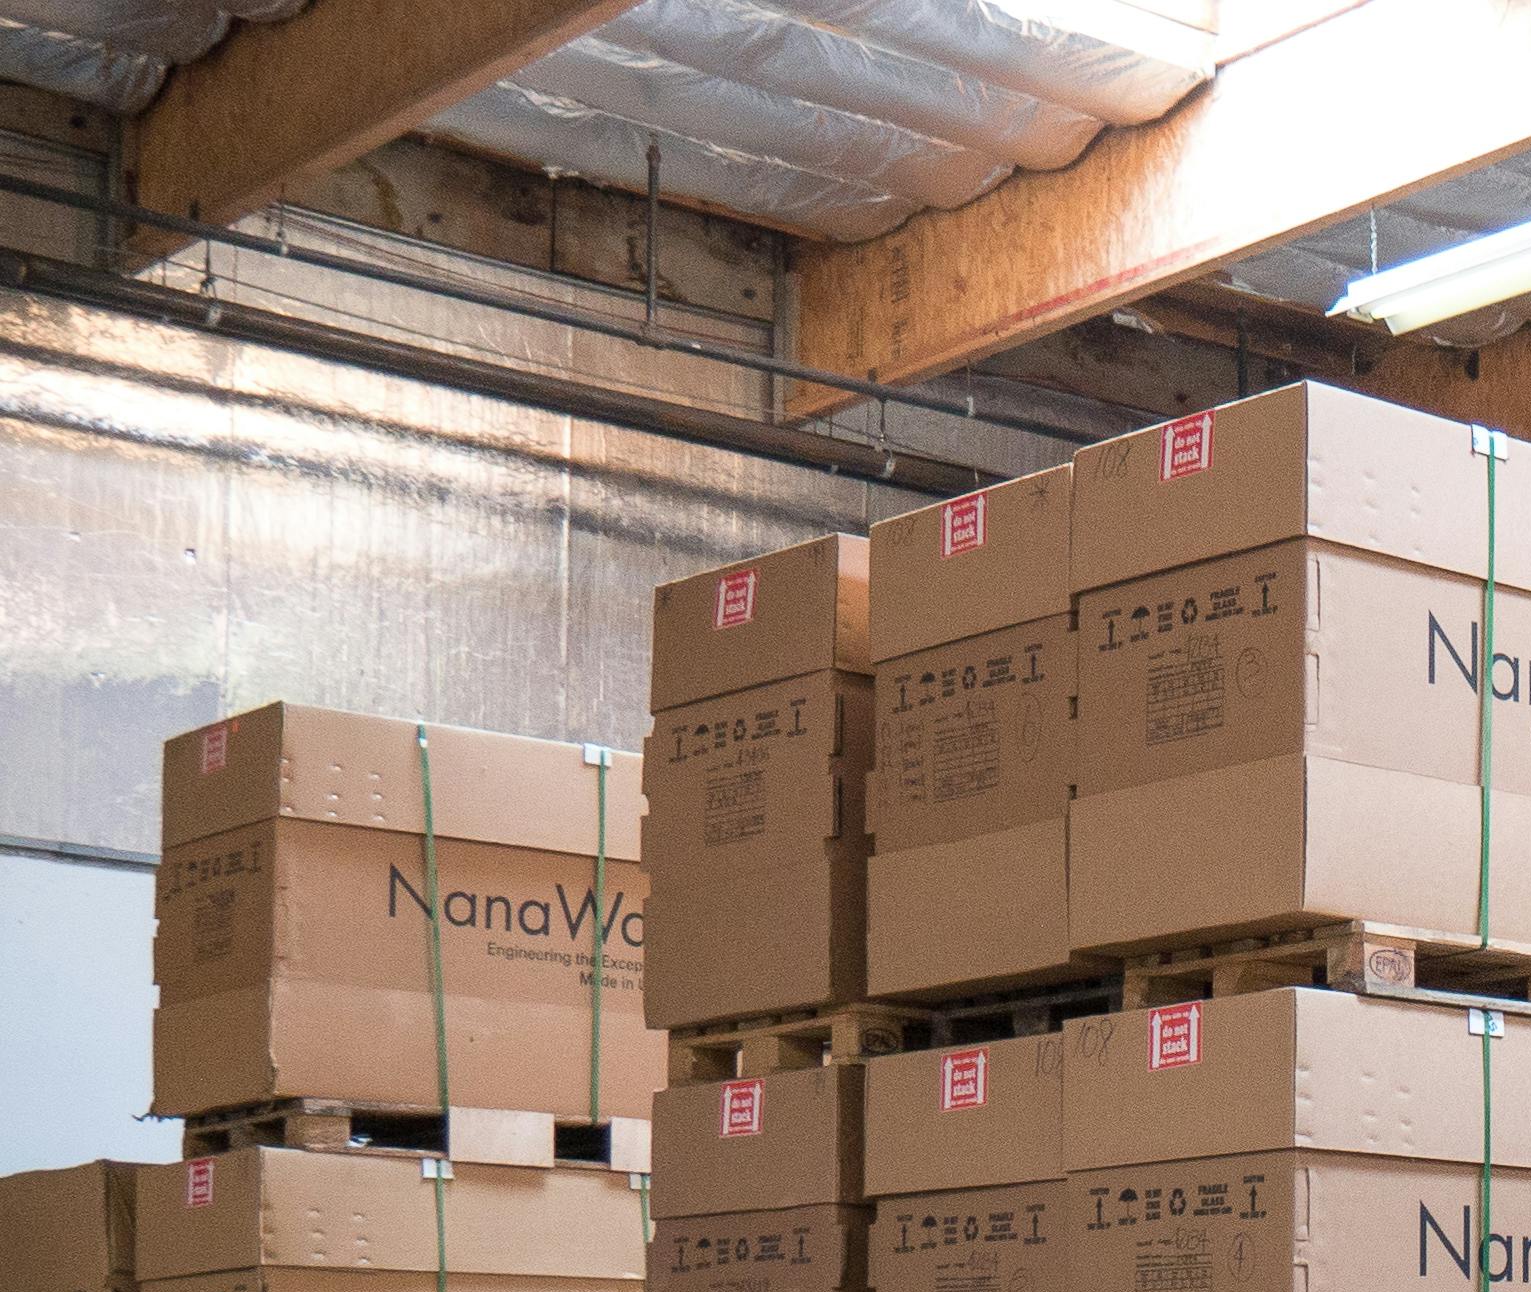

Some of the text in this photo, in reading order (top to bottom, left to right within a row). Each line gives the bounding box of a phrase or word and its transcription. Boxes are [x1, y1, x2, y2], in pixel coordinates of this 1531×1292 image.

[388, 863, 643, 947] NanaWa
[487, 943, 572, 967] Engineering
[579, 971, 617, 989] Mde
